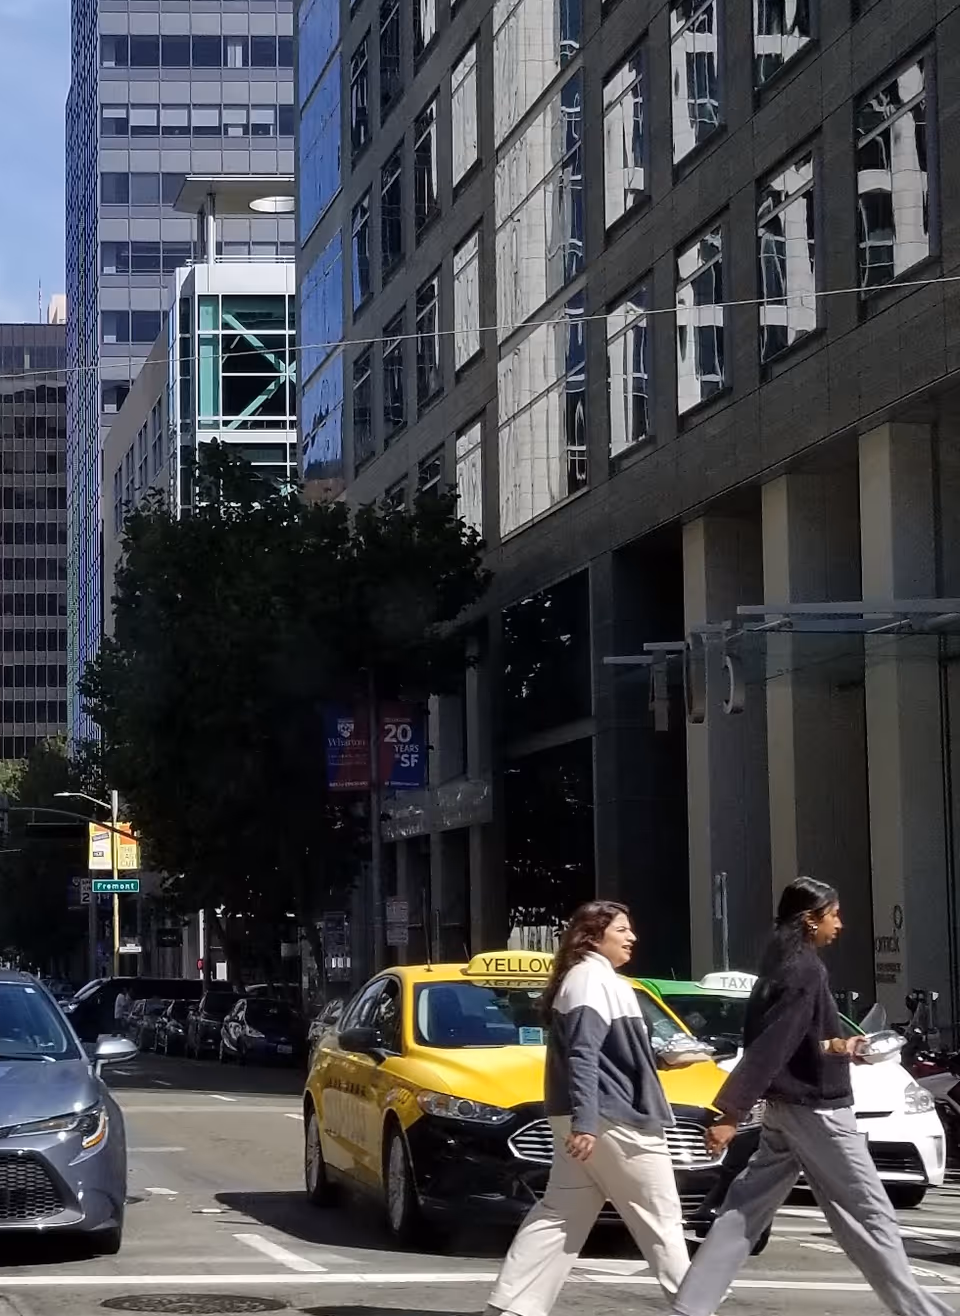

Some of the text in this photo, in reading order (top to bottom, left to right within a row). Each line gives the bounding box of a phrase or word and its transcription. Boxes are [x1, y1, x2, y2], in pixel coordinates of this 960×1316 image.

[383, 724, 412, 743] 20
[394, 744, 419, 753] YEARS
[400, 754, 419, 767] SF
[97, 882, 135, 891] Fremont
[720, 977, 754, 989] TAXI
